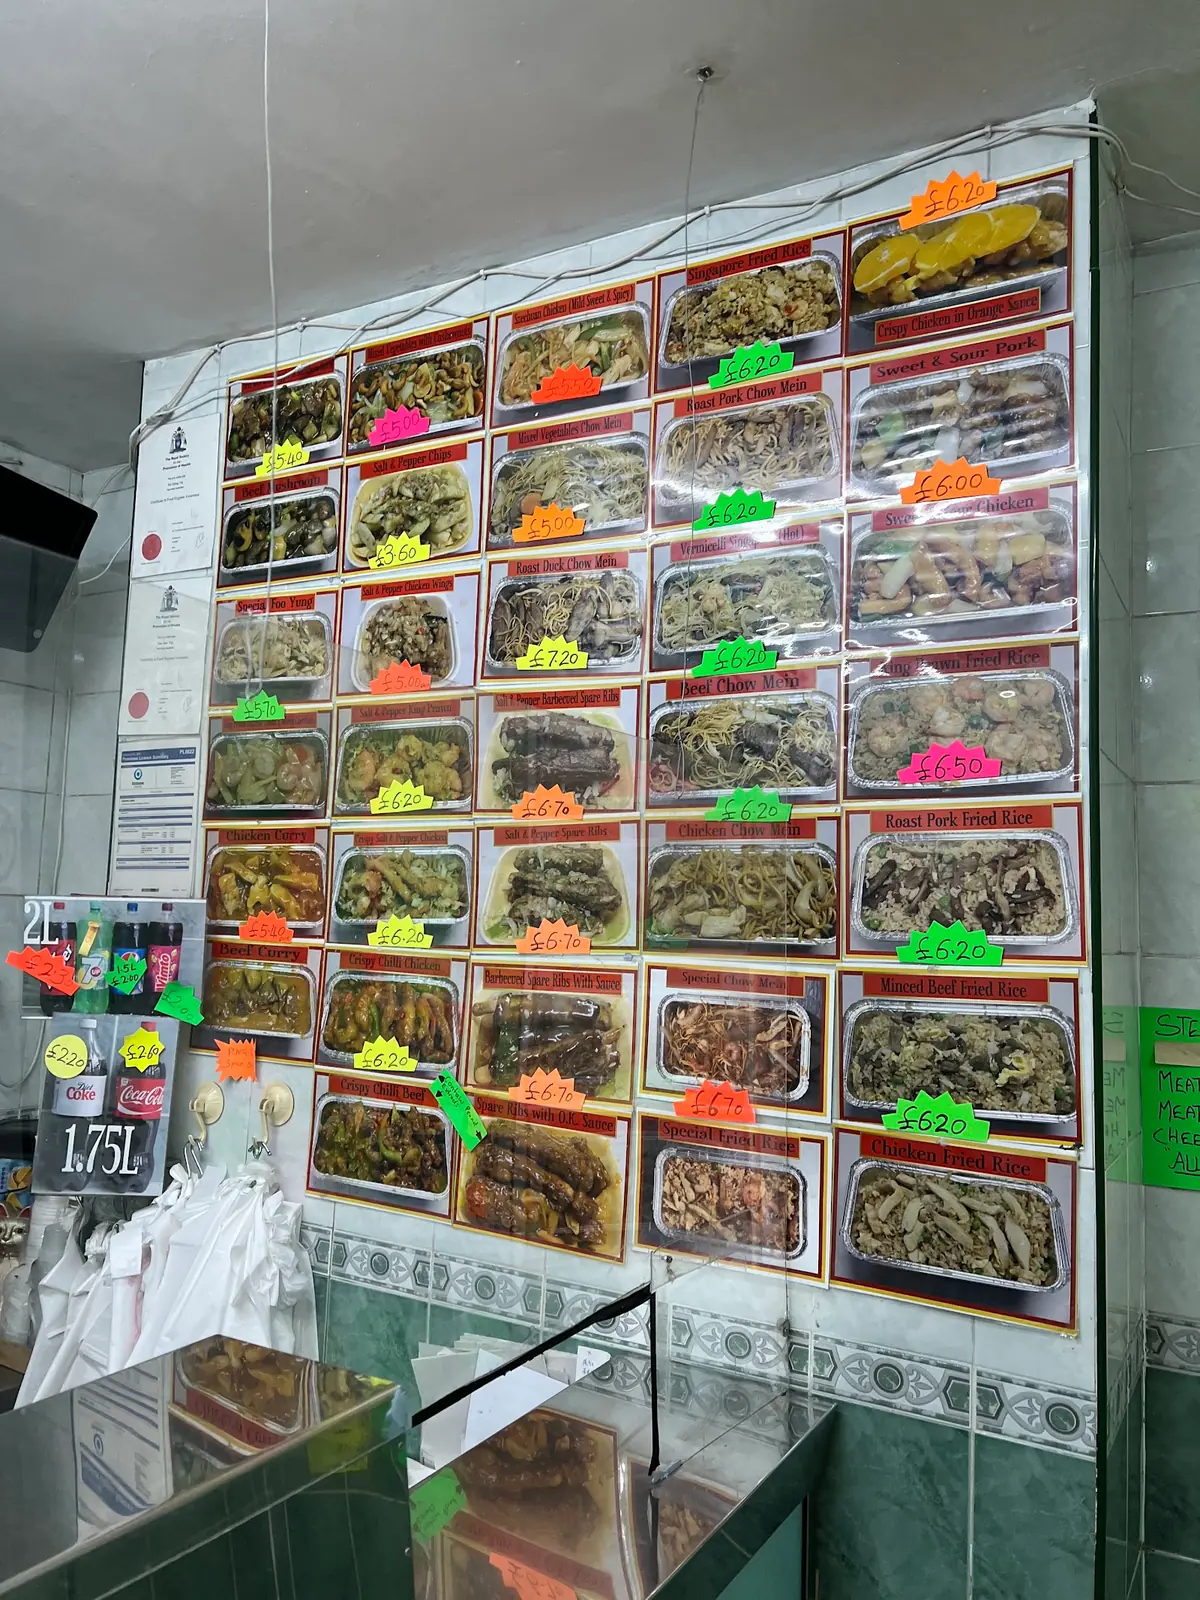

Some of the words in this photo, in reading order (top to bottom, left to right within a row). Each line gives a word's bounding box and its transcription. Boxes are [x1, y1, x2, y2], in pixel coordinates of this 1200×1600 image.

[924, 182, 985, 217] £6.20
[688, 258, 744, 281] Singapore
[748, 249, 778, 265] Fried
[782, 243, 809, 257] Rice
[543, 304, 566, 317] Chicken
[568, 298, 585, 311] (Mild
[586, 295, 605, 307] Sweet
[613, 285, 633, 302] Spicy)
[878, 321, 908, 338] Crispy
[911, 313, 950, 331] Chicken
[954, 312, 964, 322] in
[968, 303, 1003, 320] Orange
[1008, 295, 1038, 311] Sauce
[877, 361, 925, 378] Sweet
[932, 356, 943, 366] &
[950, 348, 989, 363] Sour
[996, 337, 1038, 354] Pork
[724, 355, 780, 383] £6.20
[687, 397, 715, 412] Roast
[719, 390, 743, 405] Pork
[747, 386, 776, 400] Chow
[780, 380, 807, 394] Mein
[518, 431, 538, 444] Mixed
[541, 425, 578, 443] Vegetables
[581, 420, 600, 432] Chow
[604, 417, 621, 428] Mein
[373, 460, 388, 474] Salt
[398, 454, 426, 471] Pepper
[428, 450, 452, 464] Chips
[242, 483, 264, 498] Beef
[915, 473, 982, 503] £6.00
[707, 503, 757, 526] £6.20
[976, 496, 1034, 513] Chicken
[680, 538, 726, 555] Vermicelli
[778, 526, 804, 544] (Hot)
[369, 543, 417, 568] £3.60
[517, 561, 540, 574] Roast
[543, 558, 564, 571] Duck
[568, 557, 591, 569] Chow
[595, 556, 617, 568] Mein
[362, 587, 374, 596] Salt
[381, 585, 403, 596] Pepper
[405, 582, 430, 591] Chicken
[237, 601, 268, 612] Specia
[271, 599, 286, 609] Foo
[290, 597, 313, 609] Yung
[529, 649, 579, 668] £7.20
[714, 647, 766, 672] £6.20
[966, 651, 1001, 668] Fried
[1007, 651, 1039, 666] Rice
[680, 680, 712, 697] Beef
[717, 679, 757, 693] Chow
[763, 674, 800, 689] Mein
[542, 692, 578, 706] Barbecued
[580, 691, 600, 704] Spare
[603, 689, 619, 702] Ribs
[382, 706, 406, 718] Pepper
[378, 790, 421, 810] £6.20
[522, 798, 570, 818] £6.70
[720, 799, 778, 821] £6.20
[678, 823, 726, 837] Chicken
[731, 823, 765, 837] Chow
[770, 822, 800, 836] Mein
[885, 814, 922, 828] Roast
[927, 813, 958, 827] Pork
[963, 811, 997, 826] Fried
[1002, 810, 1033, 825] Rice
[226, 830, 271, 841] Chicken
[274, 830, 307, 843] Curry
[505, 829, 520, 839] Salt
[531, 829, 559, 841] Pepper
[561, 827, 585, 839] Spare
[588, 826, 607, 836] Ribs
[377, 926, 424, 944] £6.20
[531, 932, 580, 951] £6.70
[220, 944, 254, 956] Beef
[258, 946, 300, 962] Curry
[916, 936, 985, 960] £6.20
[155, 954, 171, 992] Vimto
[349, 954, 376, 968] Crispy
[379, 956, 401, 969] Chilli
[405, 957, 441, 971] Chicken
[485, 969, 525, 985] Barbecued
[528, 972, 550, 990] Spare
[552, 975, 570, 988] Ribs
[573, 976, 593, 989] With
[596, 976, 620, 991] Sauce
[682, 972, 720, 985] Special
[724, 975, 755, 987] Chow
[880, 978, 924, 994] Minced
[928, 979, 957, 995] Beef
[960, 980, 993, 997] Fried
[997, 982, 1027, 998] Rice
[46, 1044, 84, 1067] £2.20
[362, 1049, 408, 1068] £6.20
[66, 1086, 96, 1100] Coke
[77, 1082, 93, 1090] Diet
[340, 1079, 371, 1096] Crispy
[374, 1083, 400, 1097] Chilli
[402, 1087, 426, 1100] Beef
[525, 1080, 573, 1101] £6.70
[477, 1099, 503, 1115] Spare
[507, 1103, 528, 1118] Ribs
[532, 1109, 554, 1122] with
[582, 1115, 614, 1132] Sauce
[897, 1105, 967, 1134] £6.20
[662, 1121, 713, 1140] Special
[718, 1128, 756, 1147] Fried
[762, 1137, 795, 1152] Rice
[61, 1123, 138, 1175] 1.75L
[871, 1139, 936, 1163] Chicken
[943, 1147, 985, 1169] Fried
[992, 1157, 1031, 1176] Rice
